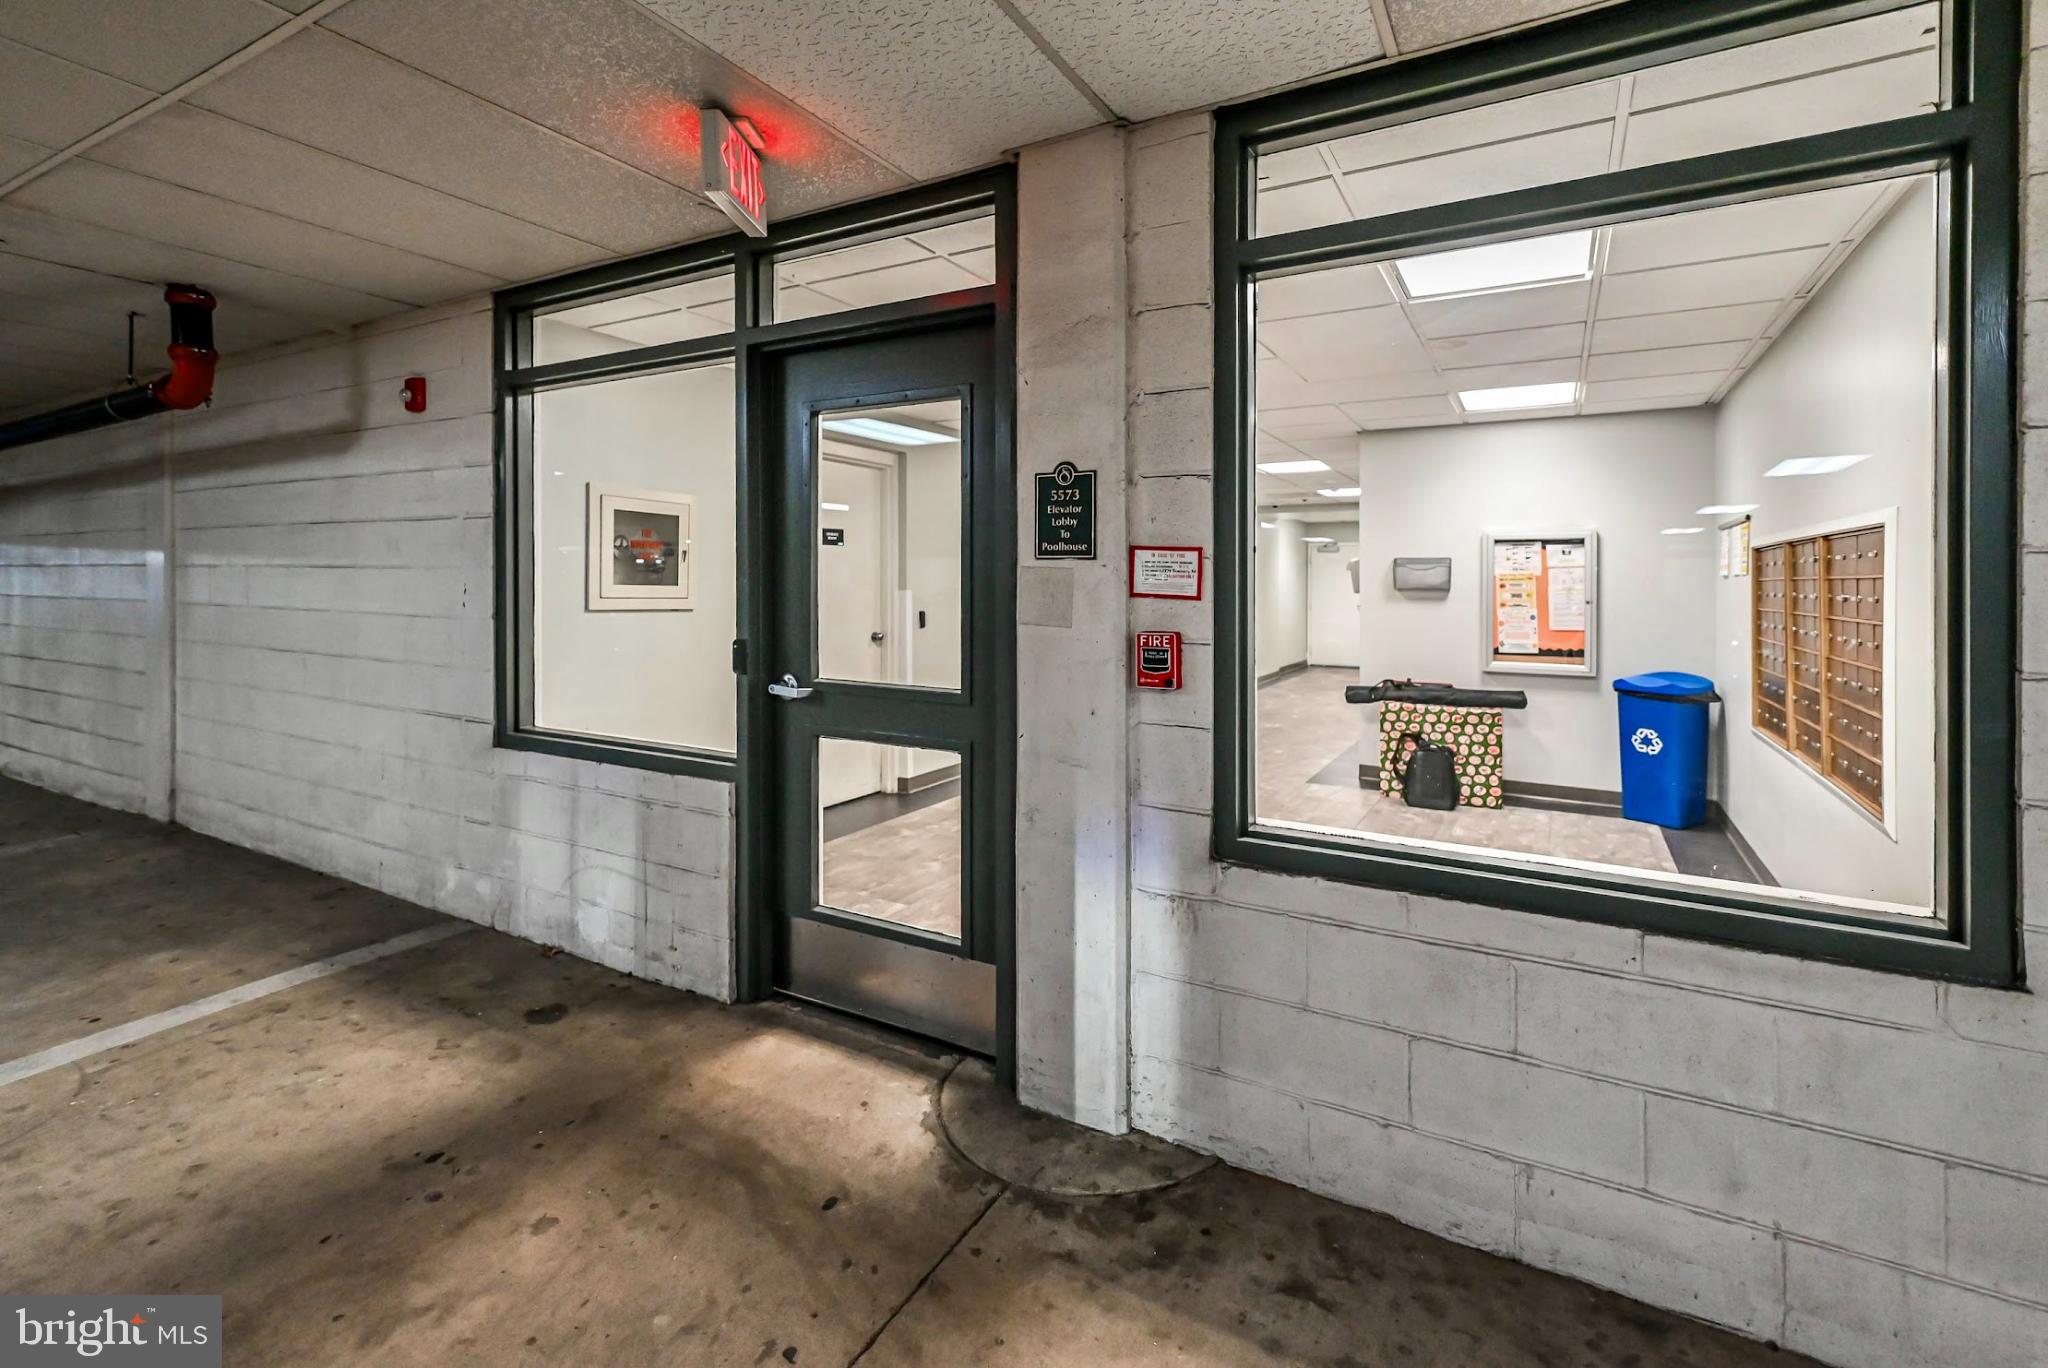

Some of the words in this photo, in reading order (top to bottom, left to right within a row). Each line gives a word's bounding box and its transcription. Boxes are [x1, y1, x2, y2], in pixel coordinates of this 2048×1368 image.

[728, 125, 762, 219] EXIT
[1050, 489, 1080, 501] 5573
[1047, 505, 1083, 514] Elevator
[1051, 516, 1078, 528] Lobby
[1060, 529, 1070, 539] To
[1042, 542, 1088, 551] Poolhouse
[1140, 635, 1171, 647] FIRE
